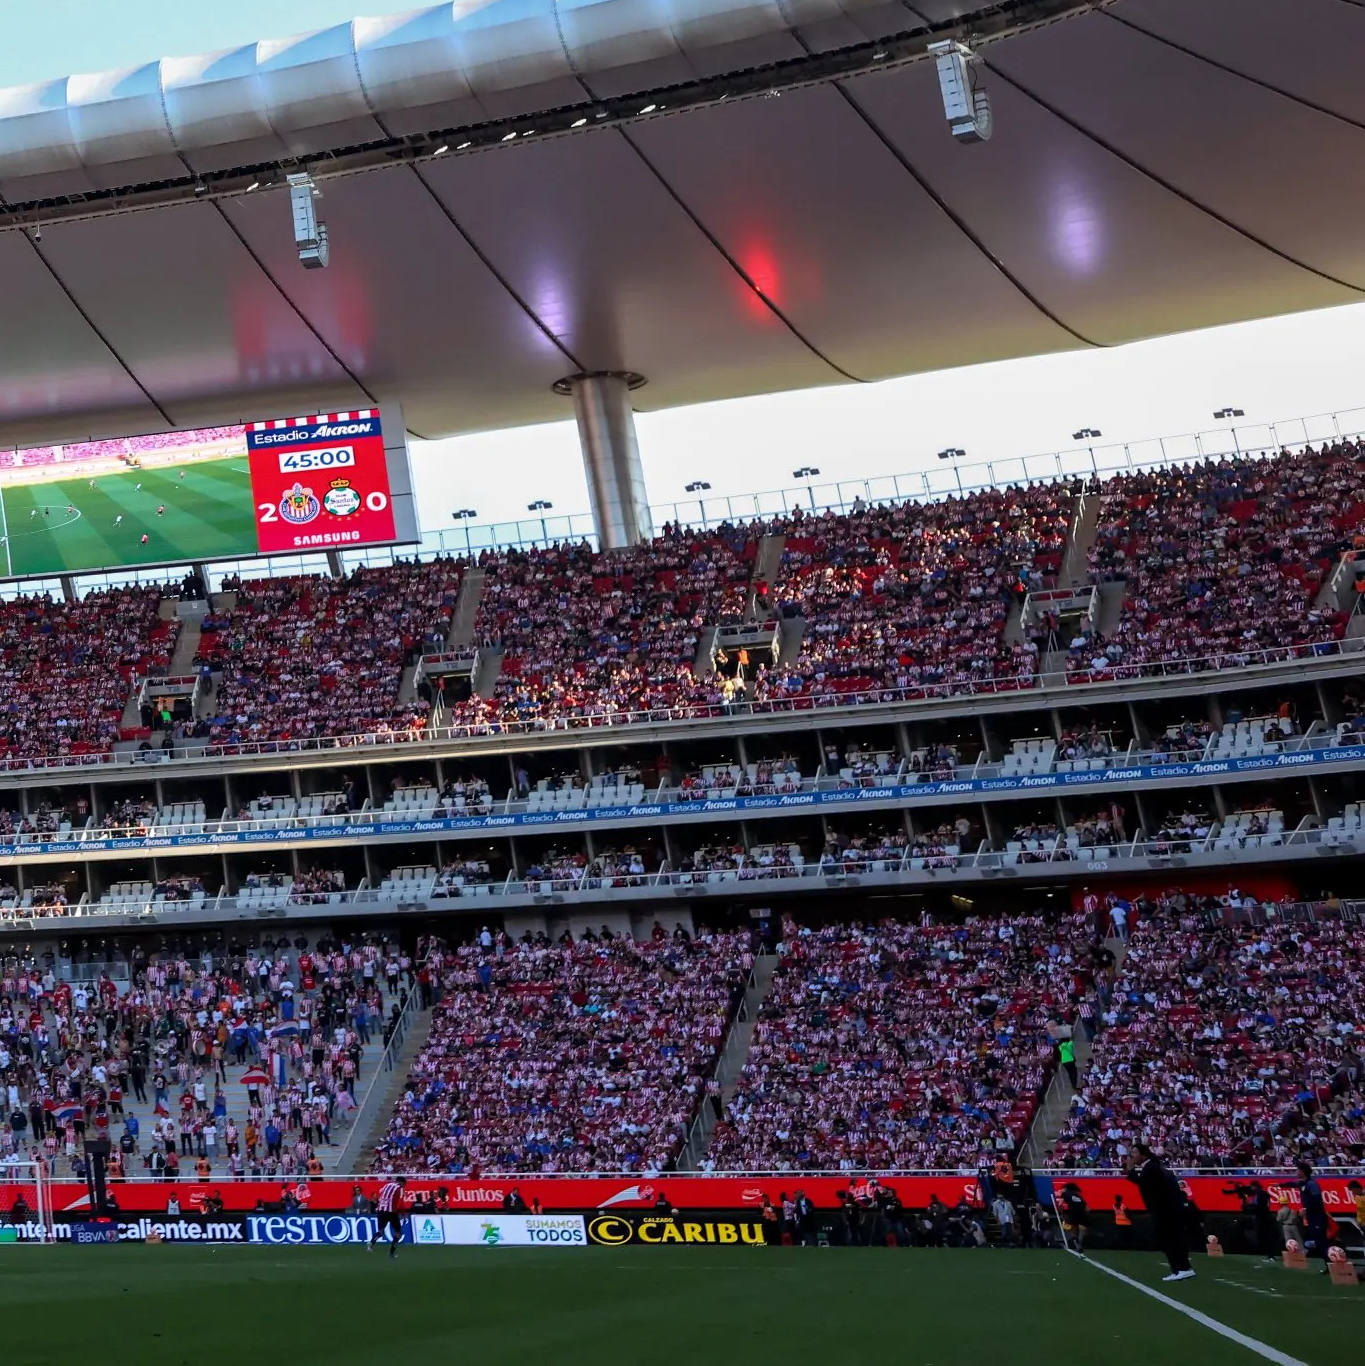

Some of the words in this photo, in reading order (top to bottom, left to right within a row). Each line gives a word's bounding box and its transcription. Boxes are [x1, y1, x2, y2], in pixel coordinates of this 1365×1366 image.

[254, 431, 309, 444] Estadio
[311, 422, 370, 438] AKRON
[284, 450, 350, 468] 45:00
[366, 492, 387, 511] 0
[258, 503, 278, 523] 2
[294, 531, 360, 546] SAMSUNG
[1237, 757, 1274, 769] Estadio
[1275, 752, 1313, 765] AKRON
[1323, 748, 1360, 761] Estadio
[1151, 765, 1189, 777] Estadio
[1190, 760, 1228, 773] AKRON
[982, 778, 1017, 790] Estadio
[1018, 774, 1057, 787] AKRON
[1065, 772, 1101, 784] Estadio
[1102, 768, 1141, 780] AKRON
[822, 791, 855, 802] Estadio
[856, 787, 892, 799] AKRON
[901, 785, 936, 796] Estadio
[937, 781, 972, 793] AKRON
[669, 803, 701, 813] Estadio
[702, 799, 736, 810] AKRON
[745, 797, 777, 808] Estadio
[778, 793, 813, 805] AKRON
[523, 813, 553, 823] Estadio
[554, 810, 587, 821] AKRON
[595, 808, 626, 818] Estadio
[627, 805, 660, 816] AKRON
[382, 823, 411, 832] Estadio
[412, 820, 443, 830] AKRON
[451, 818, 481, 828] Estadio
[482, 815, 514, 826] AKRON
[245, 832, 274, 841] Estadio
[275, 829, 305, 839] AKRON
[313, 827, 342, 837] Estadio
[343, 825, 373, 835] AKRON
[113, 840, 140, 849] Estadio
[141, 837, 171, 847] AKRON
[179, 836, 207, 845] Estadio
[208, 833, 238, 843] AKRON
[13, 844, 41, 854] AKRON
[48, 843, 75, 852] Estadio
[76, 841, 105, 850] AKRON
[1087, 861, 1108, 870] 003
[526, 1220, 581, 1228] SUMAMOS
[78, 1232, 105, 1243] BBVA
[527, 1229, 582, 1242] TODOS
[638, 1223, 765, 1243] CARIBU
